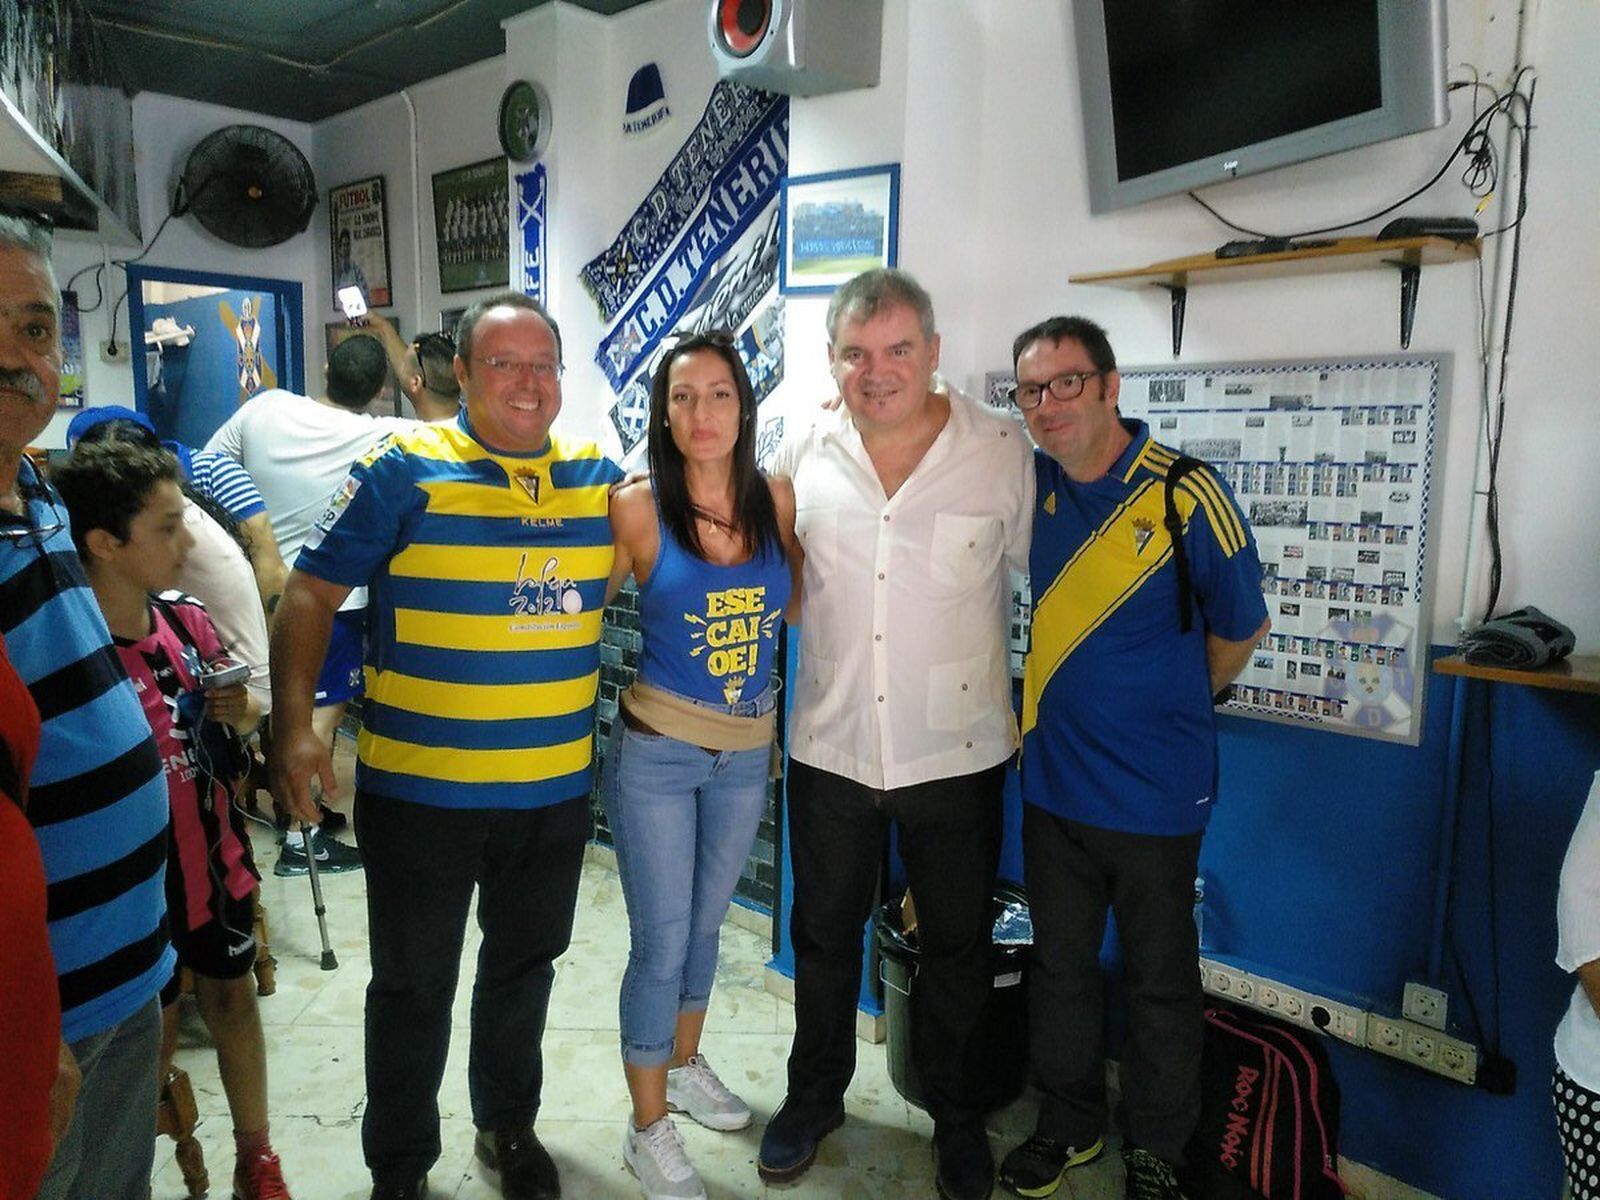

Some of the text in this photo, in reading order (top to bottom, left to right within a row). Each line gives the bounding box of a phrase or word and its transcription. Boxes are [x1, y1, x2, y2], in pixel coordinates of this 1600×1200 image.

[520, 516, 564, 528] KELME
[706, 586, 766, 618] ESE
[706, 616, 761, 648] CAI
[707, 643, 758, 677] OE!
